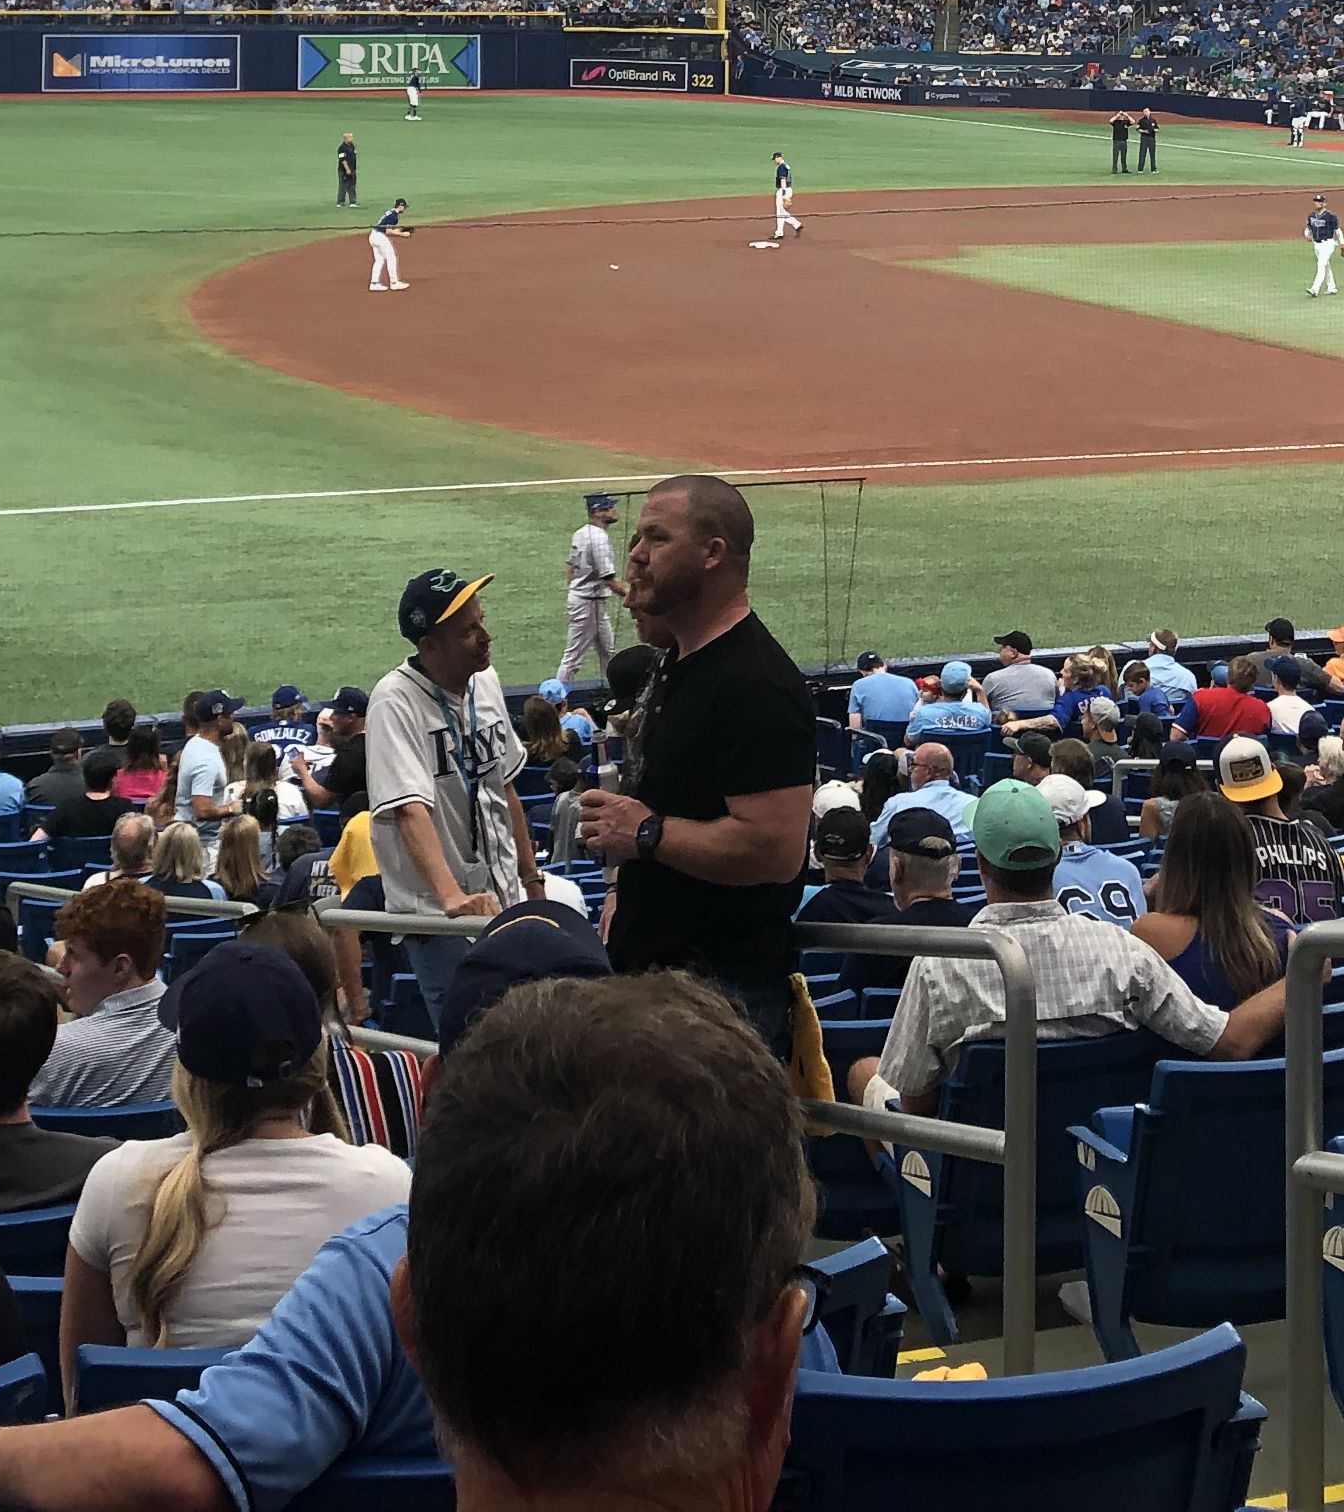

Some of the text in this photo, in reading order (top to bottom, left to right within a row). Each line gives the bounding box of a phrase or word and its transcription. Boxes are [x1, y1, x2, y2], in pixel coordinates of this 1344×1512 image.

[90, 54, 231, 68] MicroLumen
[368, 42, 449, 75] RIPA
[350, 76, 404, 84] CELEBRATING
[608, 68, 677, 83] OptiBrand Rx
[691, 74, 714, 88] 322
[834, 85, 854, 98] MLB
[856, 87, 902, 101] NETWORK
[253, 727, 310, 744] GONZALEZ
[1256, 844, 1328, 871] PHILLIPS
